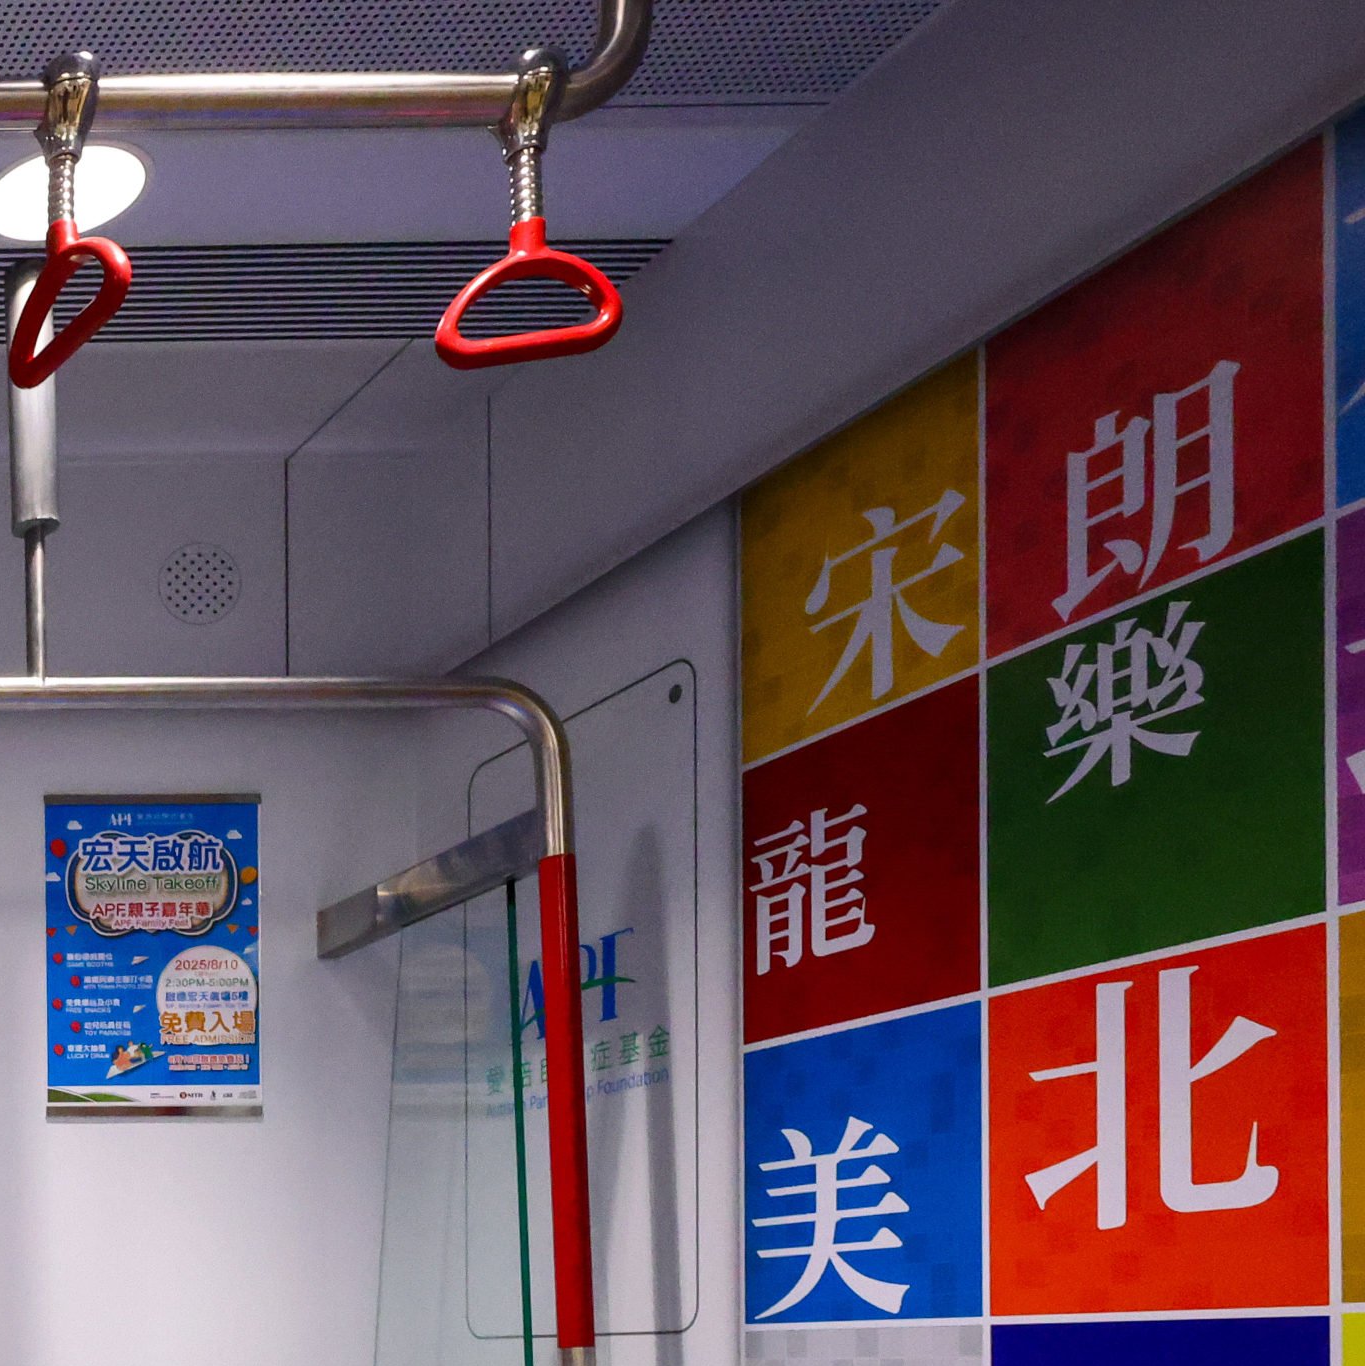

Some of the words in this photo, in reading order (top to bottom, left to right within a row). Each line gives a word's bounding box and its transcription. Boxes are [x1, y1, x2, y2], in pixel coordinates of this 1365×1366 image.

[1051, 359, 1241, 623] 朗
[805, 489, 966, 717] 宋
[1043, 601, 1206, 804] 樂
[82, 839, 220, 872] 宏天啟航
[85, 877, 147, 891] Skyline
[152, 876, 216, 889] Takeoff
[748, 803, 876, 975] 龍
[160, 1010, 255, 1034] 免費入場
[162, 1034, 191, 1043] FREE
[193, 1034, 255, 1044] ADMISSION
[175, 959, 239, 970] 2025/8/10
[1025, 966, 1279, 1230] 北
[752, 1115, 910, 1320] 美
